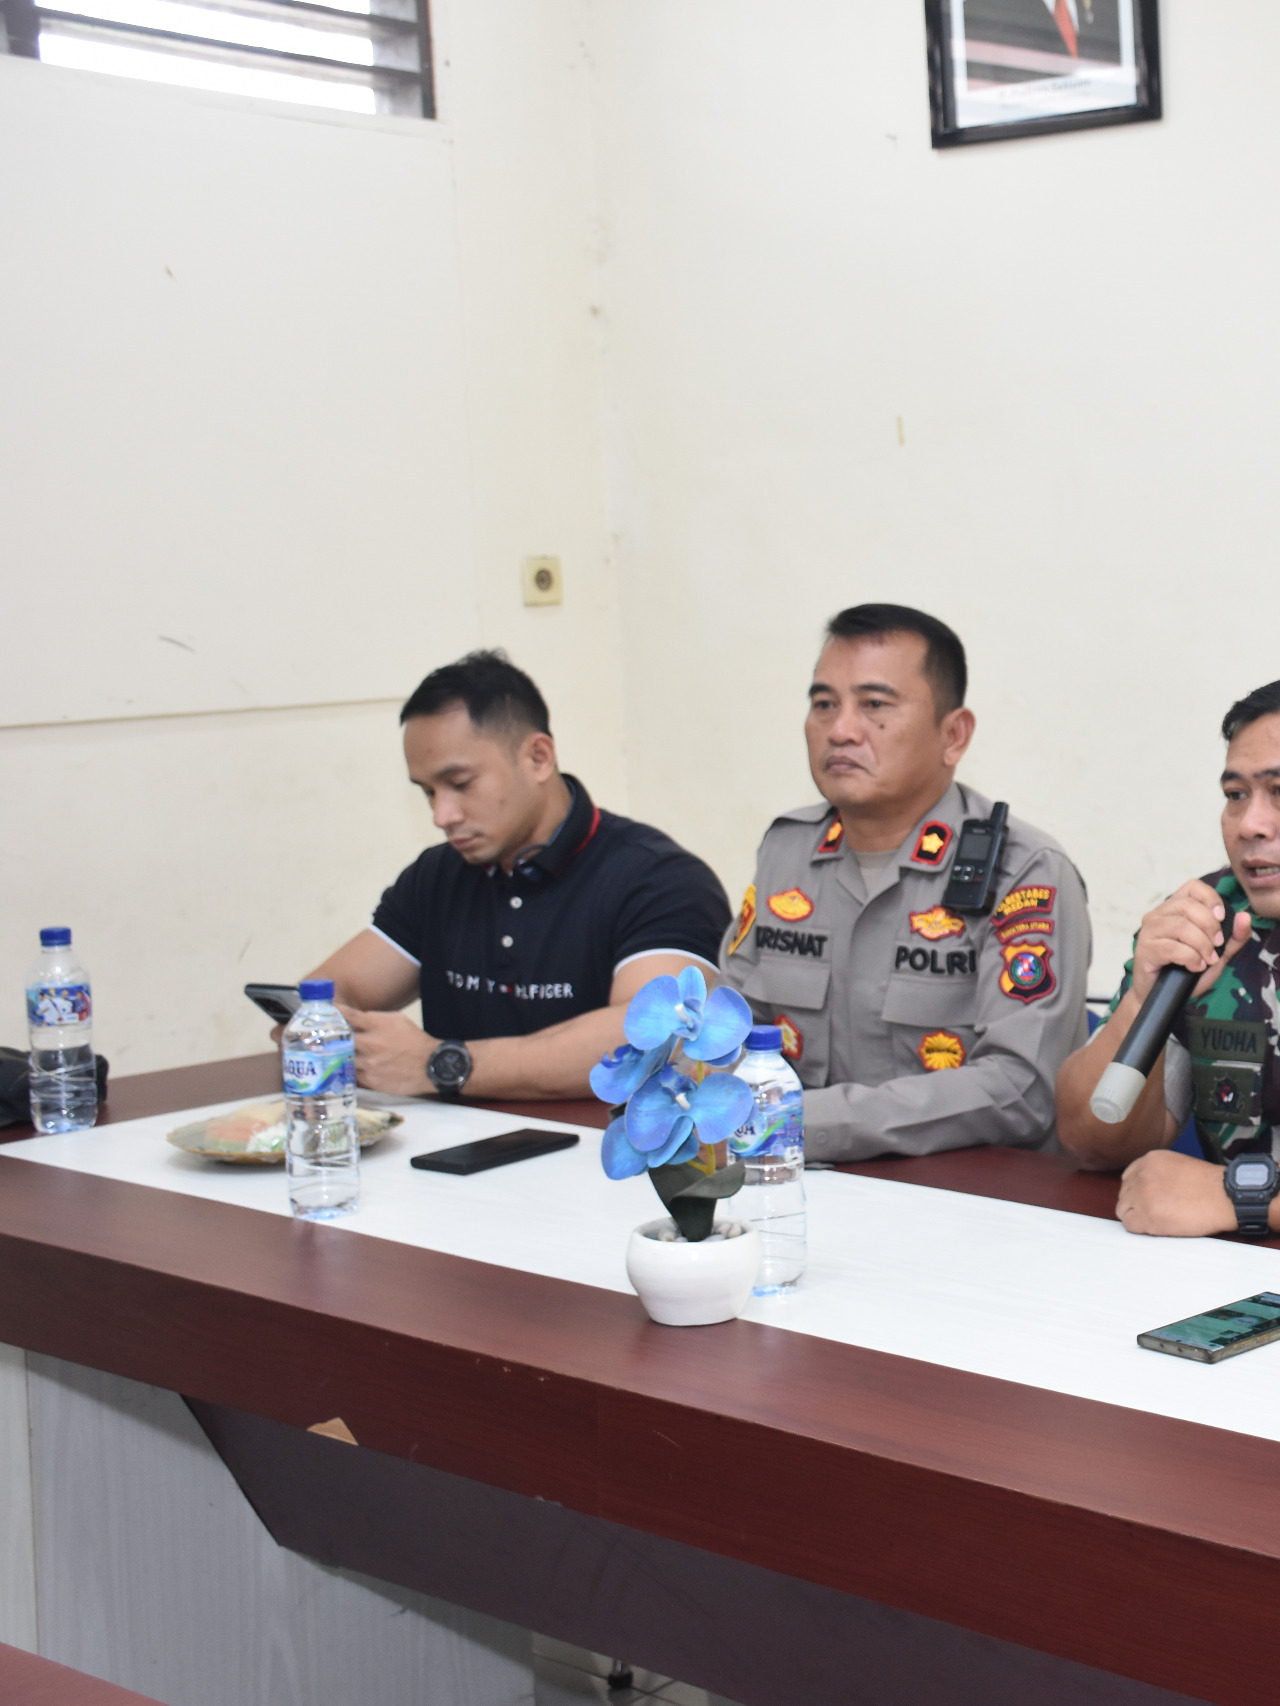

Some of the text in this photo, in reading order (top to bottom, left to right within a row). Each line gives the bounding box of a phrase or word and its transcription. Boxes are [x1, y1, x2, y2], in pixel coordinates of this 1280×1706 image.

[896, 945, 976, 974] POLRI
[446, 969, 496, 994] TOMY
[1201, 1027, 1257, 1053] YUDHA
